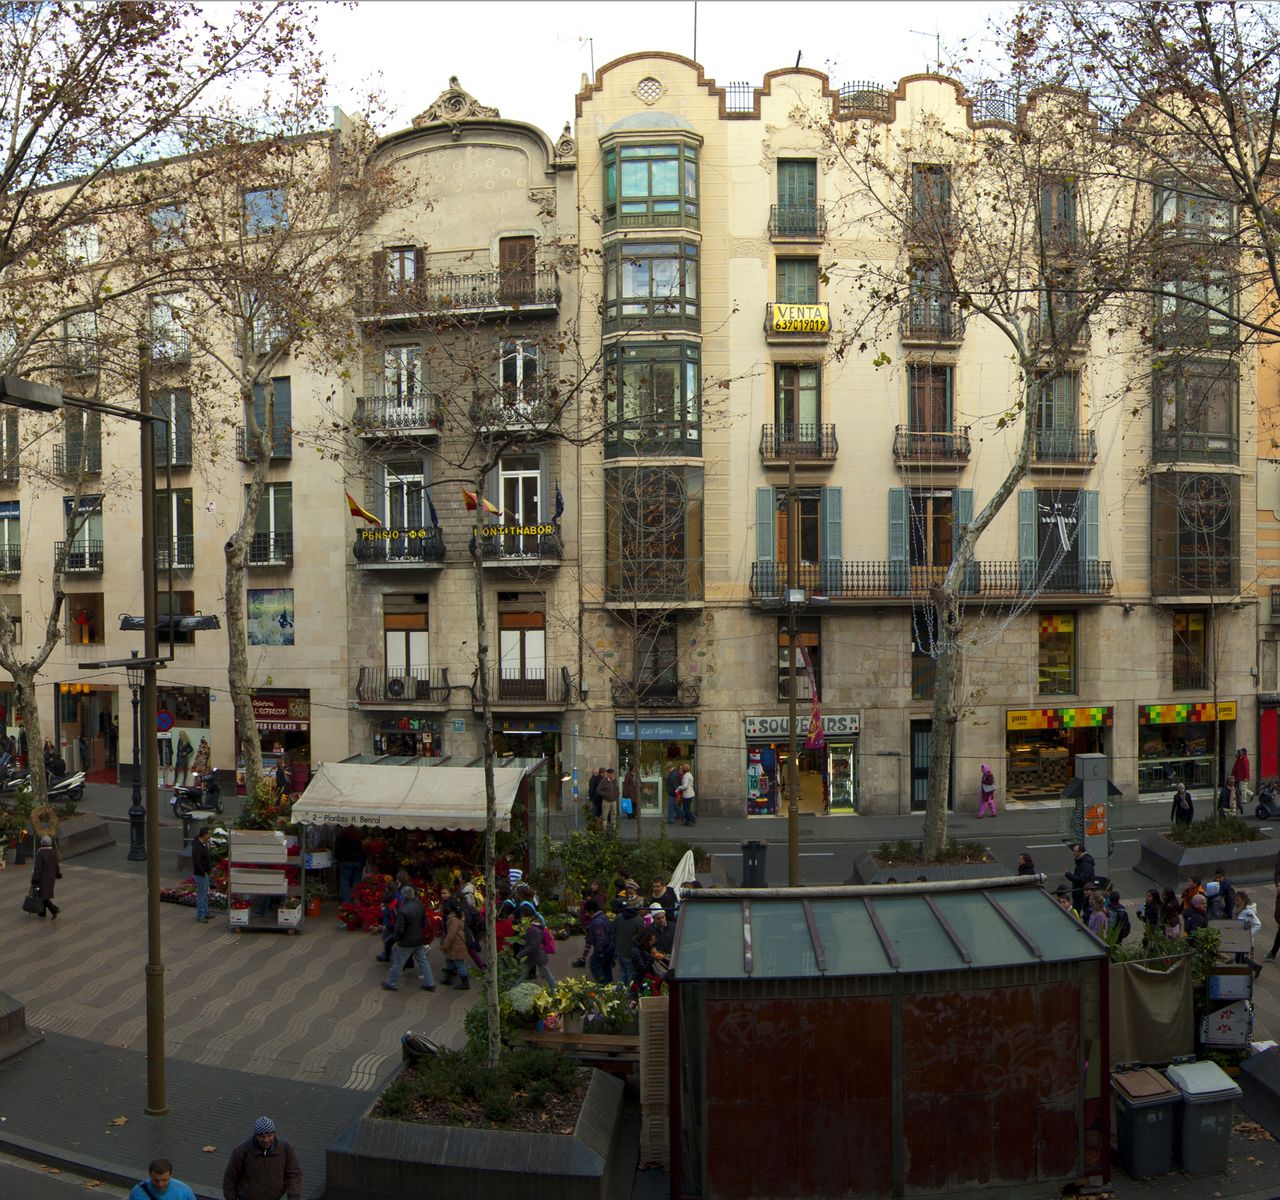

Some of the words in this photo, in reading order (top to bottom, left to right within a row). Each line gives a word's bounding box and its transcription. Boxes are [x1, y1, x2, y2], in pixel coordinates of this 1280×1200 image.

[777, 305, 823, 319] VENTA
[775, 319, 826, 331] 639019019
[758, 717, 848, 734] SOUEIRS
